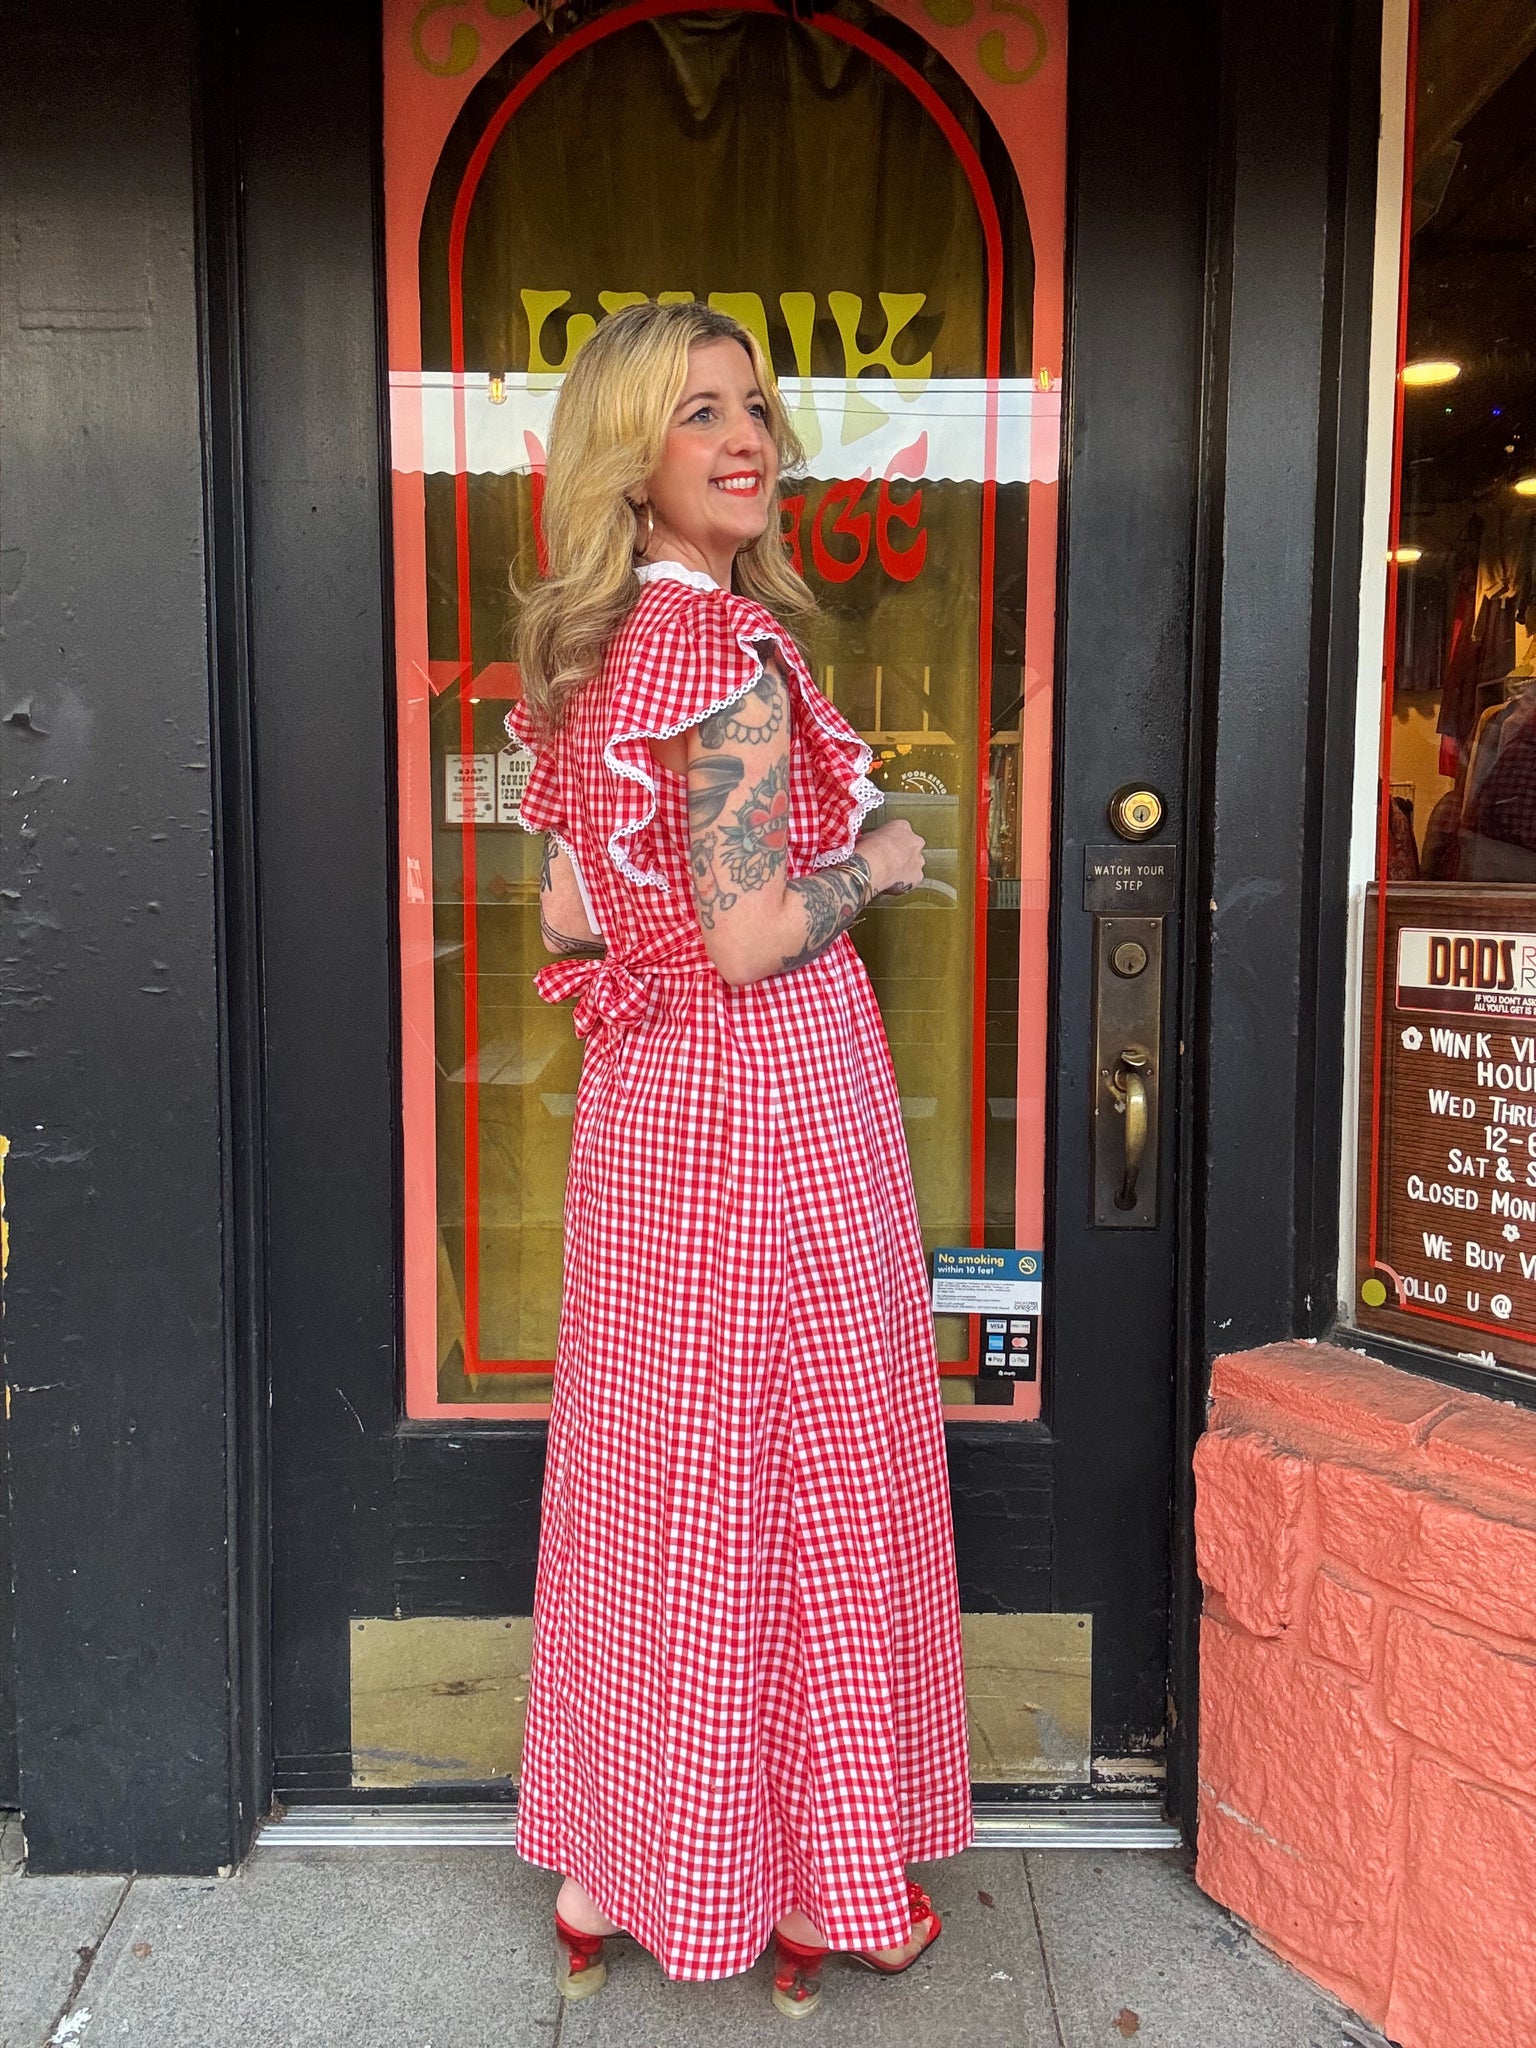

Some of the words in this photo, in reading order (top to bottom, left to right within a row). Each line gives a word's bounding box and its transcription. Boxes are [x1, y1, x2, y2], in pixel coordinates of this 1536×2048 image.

[520, 288, 932, 460] WNK
[1094, 865, 1131, 876] WATCH
[1137, 865, 1165, 876] YOUR
[1115, 880, 1143, 891] STEP
[1474, 1003, 1486, 1011] ALL
[1486, 1004, 1509, 1013] YOU'LL
[1510, 1006, 1524, 1014] GET
[1525, 1007, 1532, 1015] IS
[1475, 994, 1482, 1002] IF
[1482, 994, 1497, 1003] YOU
[1498, 996, 1521, 1005] DON'T
[1429, 1027, 1492, 1060] WINK
[1477, 1061, 1536, 1093] HOU
[1428, 1088, 1476, 1119] WED
[1488, 1095, 1536, 1128] THRU
[1448, 1149, 1490, 1178] SAT
[1495, 1156, 1516, 1183] &
[1407, 1175, 1478, 1210] CLOSED
[938, 1253, 955, 1264] No
[958, 1254, 1005, 1268] smoking
[1423, 1231, 1453, 1262] WE
[1466, 1241, 1505, 1273] BUY
[937, 1265, 964, 1274] within
[965, 1265, 975, 1274] 10
[977, 1266, 994, 1275] feet
